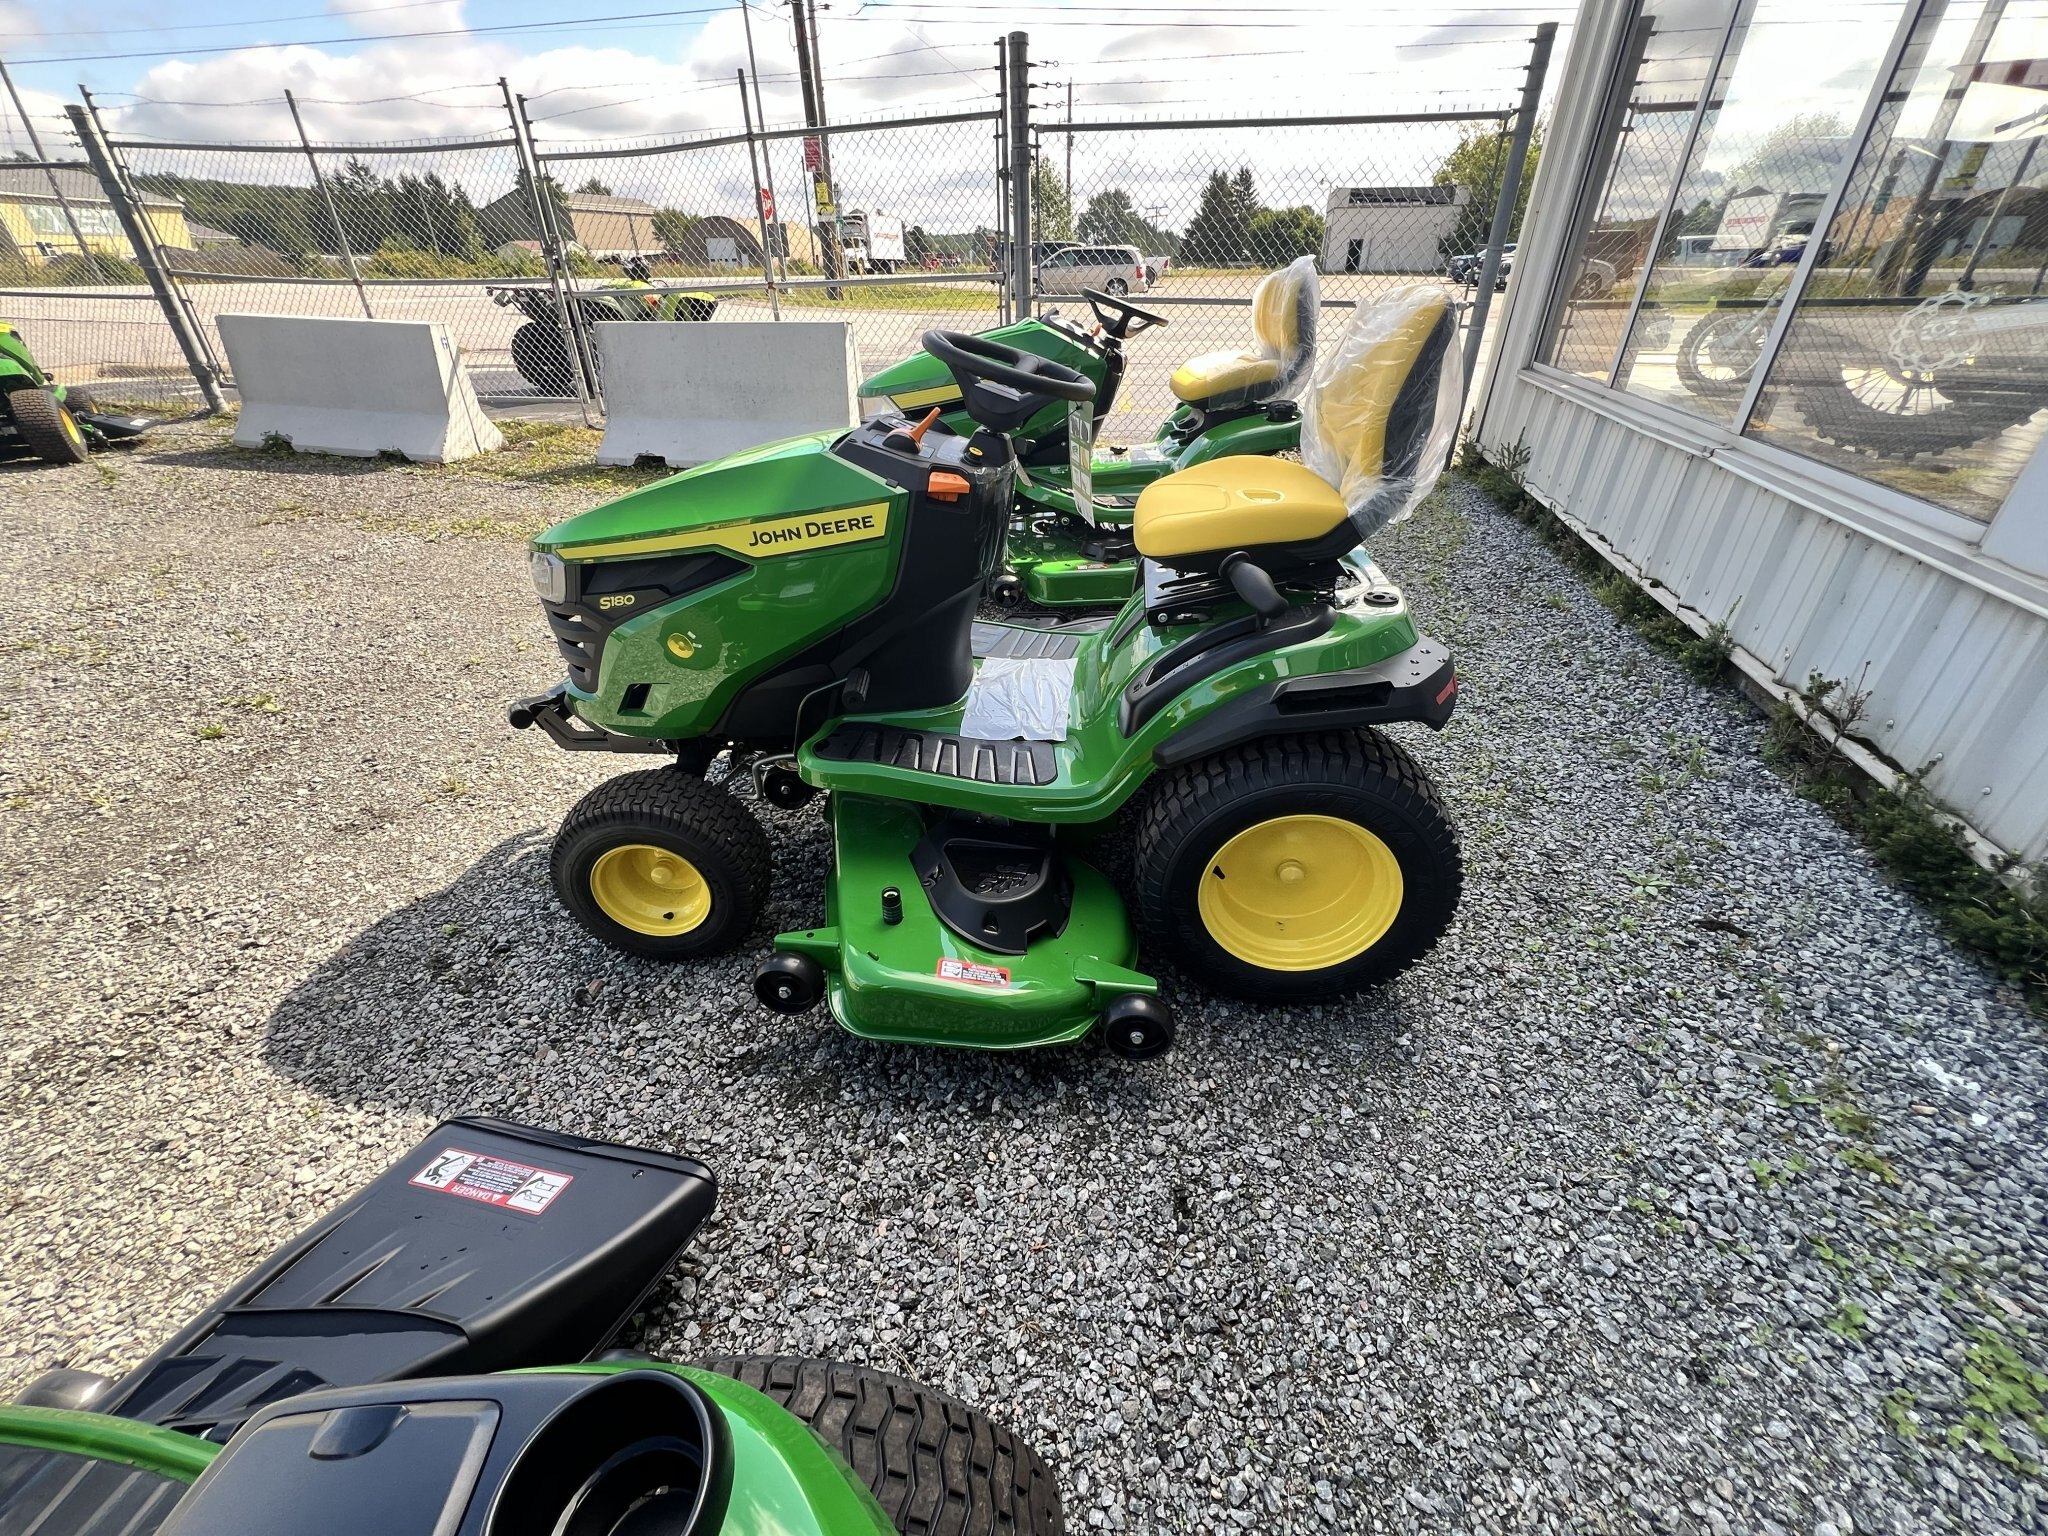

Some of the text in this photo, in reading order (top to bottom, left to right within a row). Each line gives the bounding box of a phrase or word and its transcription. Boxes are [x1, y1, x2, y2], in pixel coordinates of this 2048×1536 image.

[748, 515, 875, 547] JOHN DEERE
[599, 594, 636, 610] S180
[450, 1184, 493, 1200] DANGER
